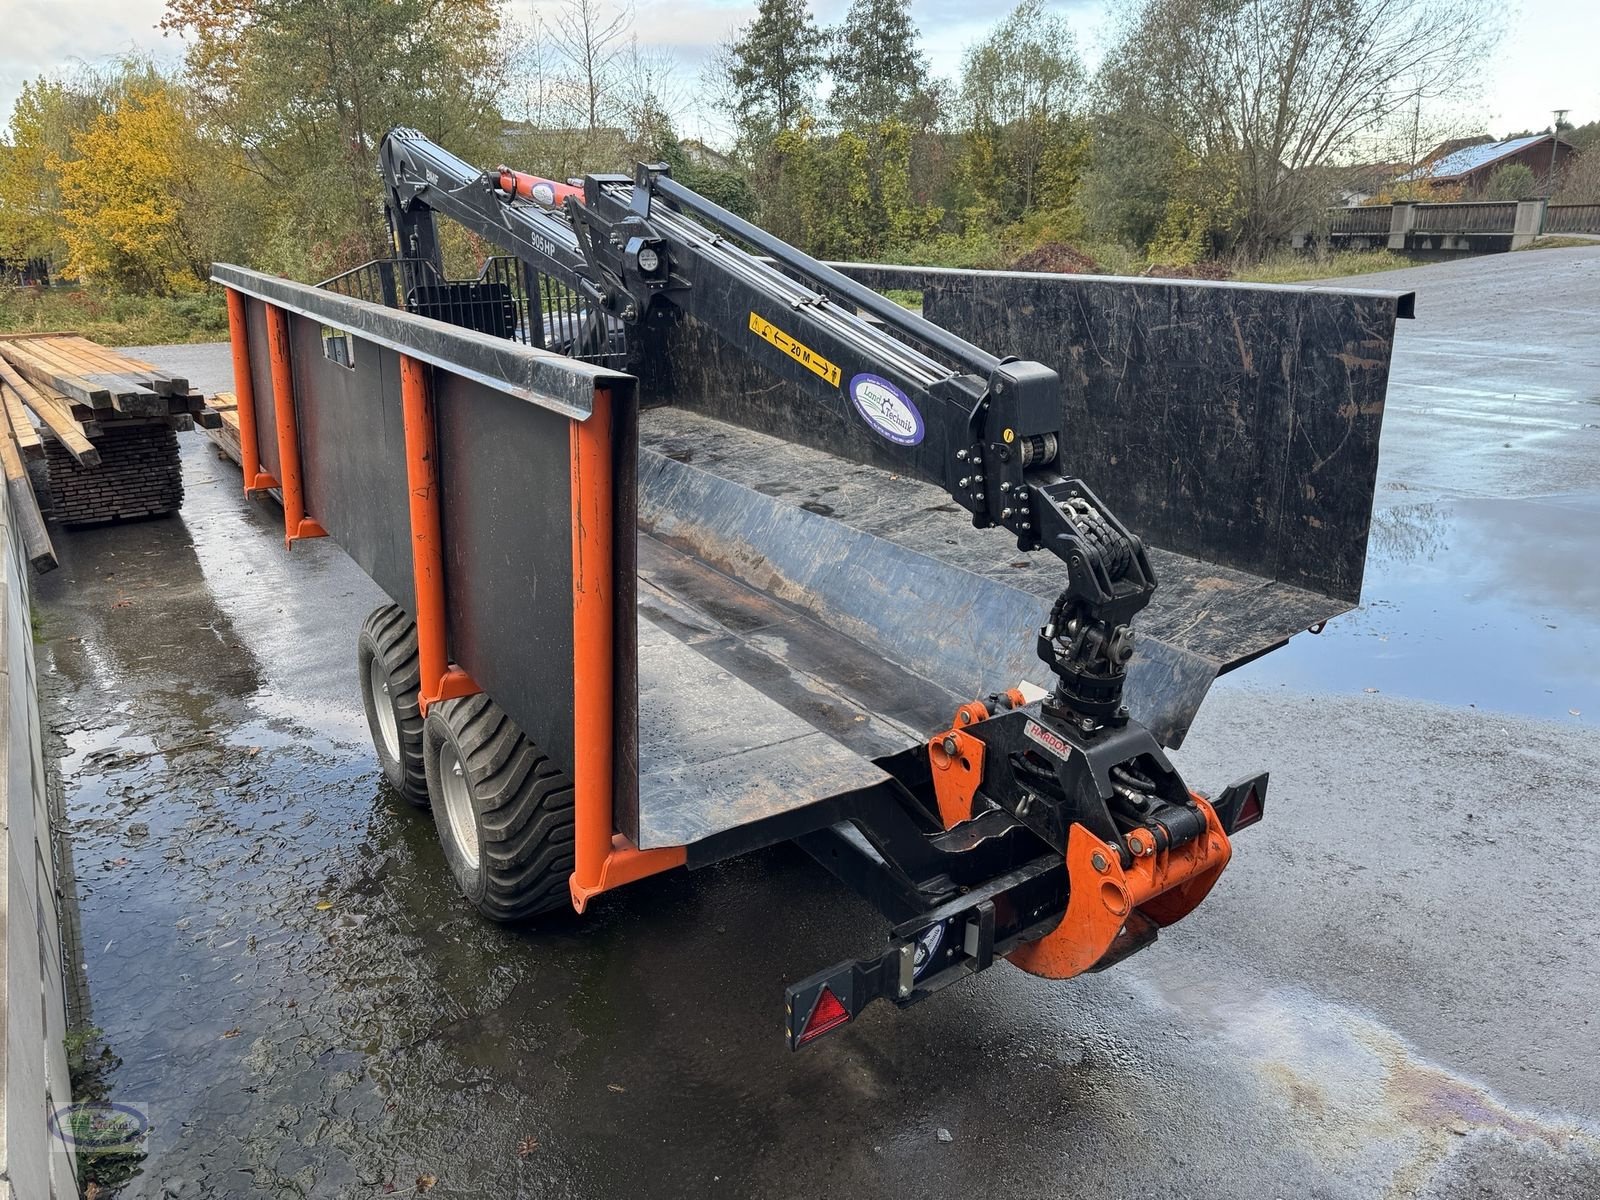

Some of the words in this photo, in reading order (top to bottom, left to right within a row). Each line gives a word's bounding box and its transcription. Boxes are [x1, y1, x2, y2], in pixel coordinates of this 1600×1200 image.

[790, 343, 801, 357] 20
[803, 350, 811, 364] M
[864, 386, 883, 404] Land
[886, 408, 912, 433] Technik
[1030, 724, 1069, 755] HARDOX
